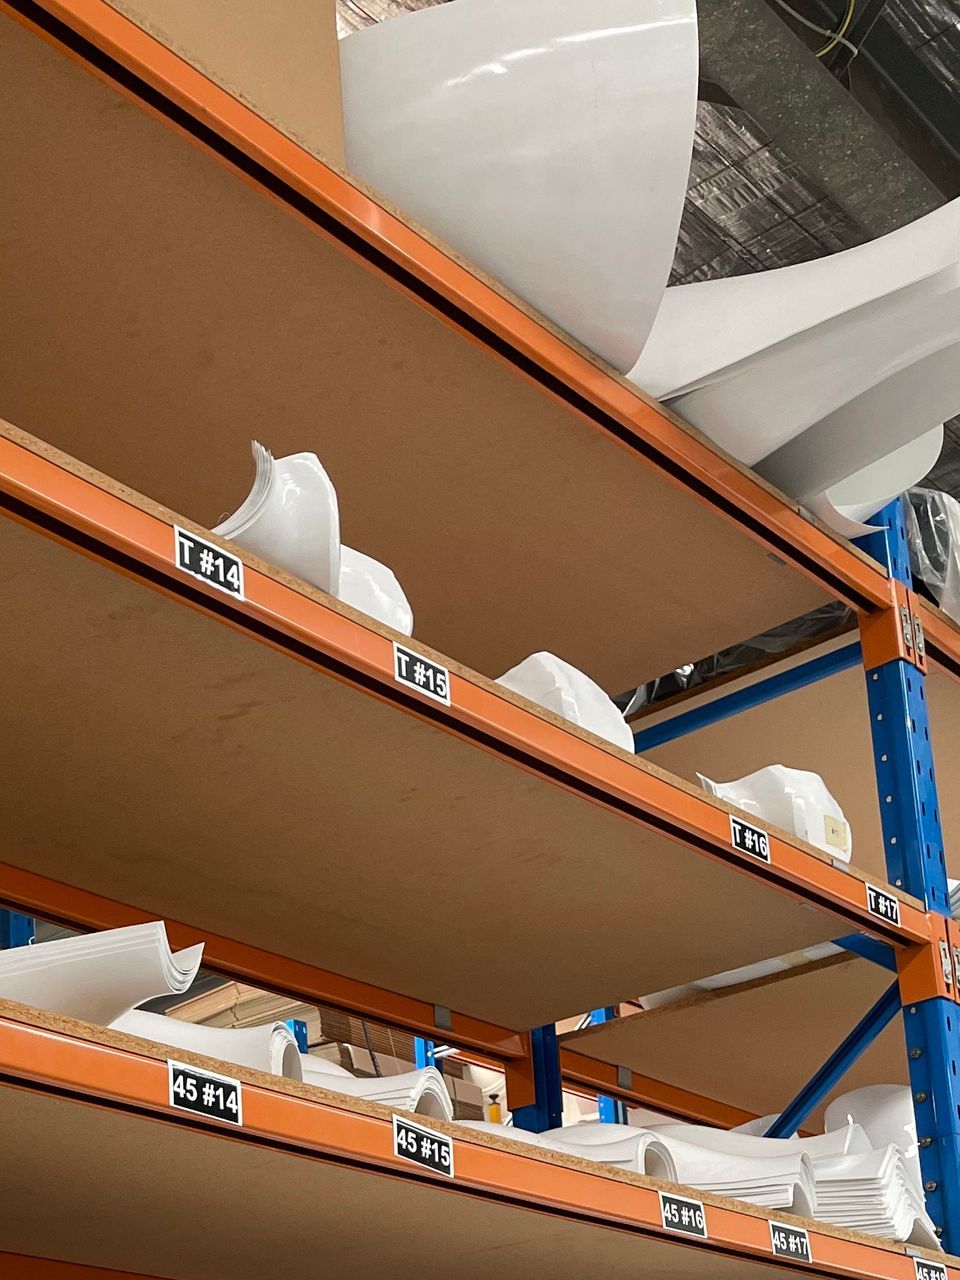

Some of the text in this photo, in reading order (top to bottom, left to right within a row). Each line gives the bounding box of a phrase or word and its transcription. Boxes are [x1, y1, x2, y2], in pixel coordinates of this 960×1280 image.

[179, 540, 240, 590] T #14
[396, 651, 447, 696] T #15
[732, 822, 768, 857] T #16
[868, 891, 898, 919] T #17
[174, 1075, 238, 1114] 45 #14
[397, 1129, 451, 1167] 45 #15
[664, 1202, 704, 1229] 45 #16
[774, 1231, 807, 1255] 45 #17
